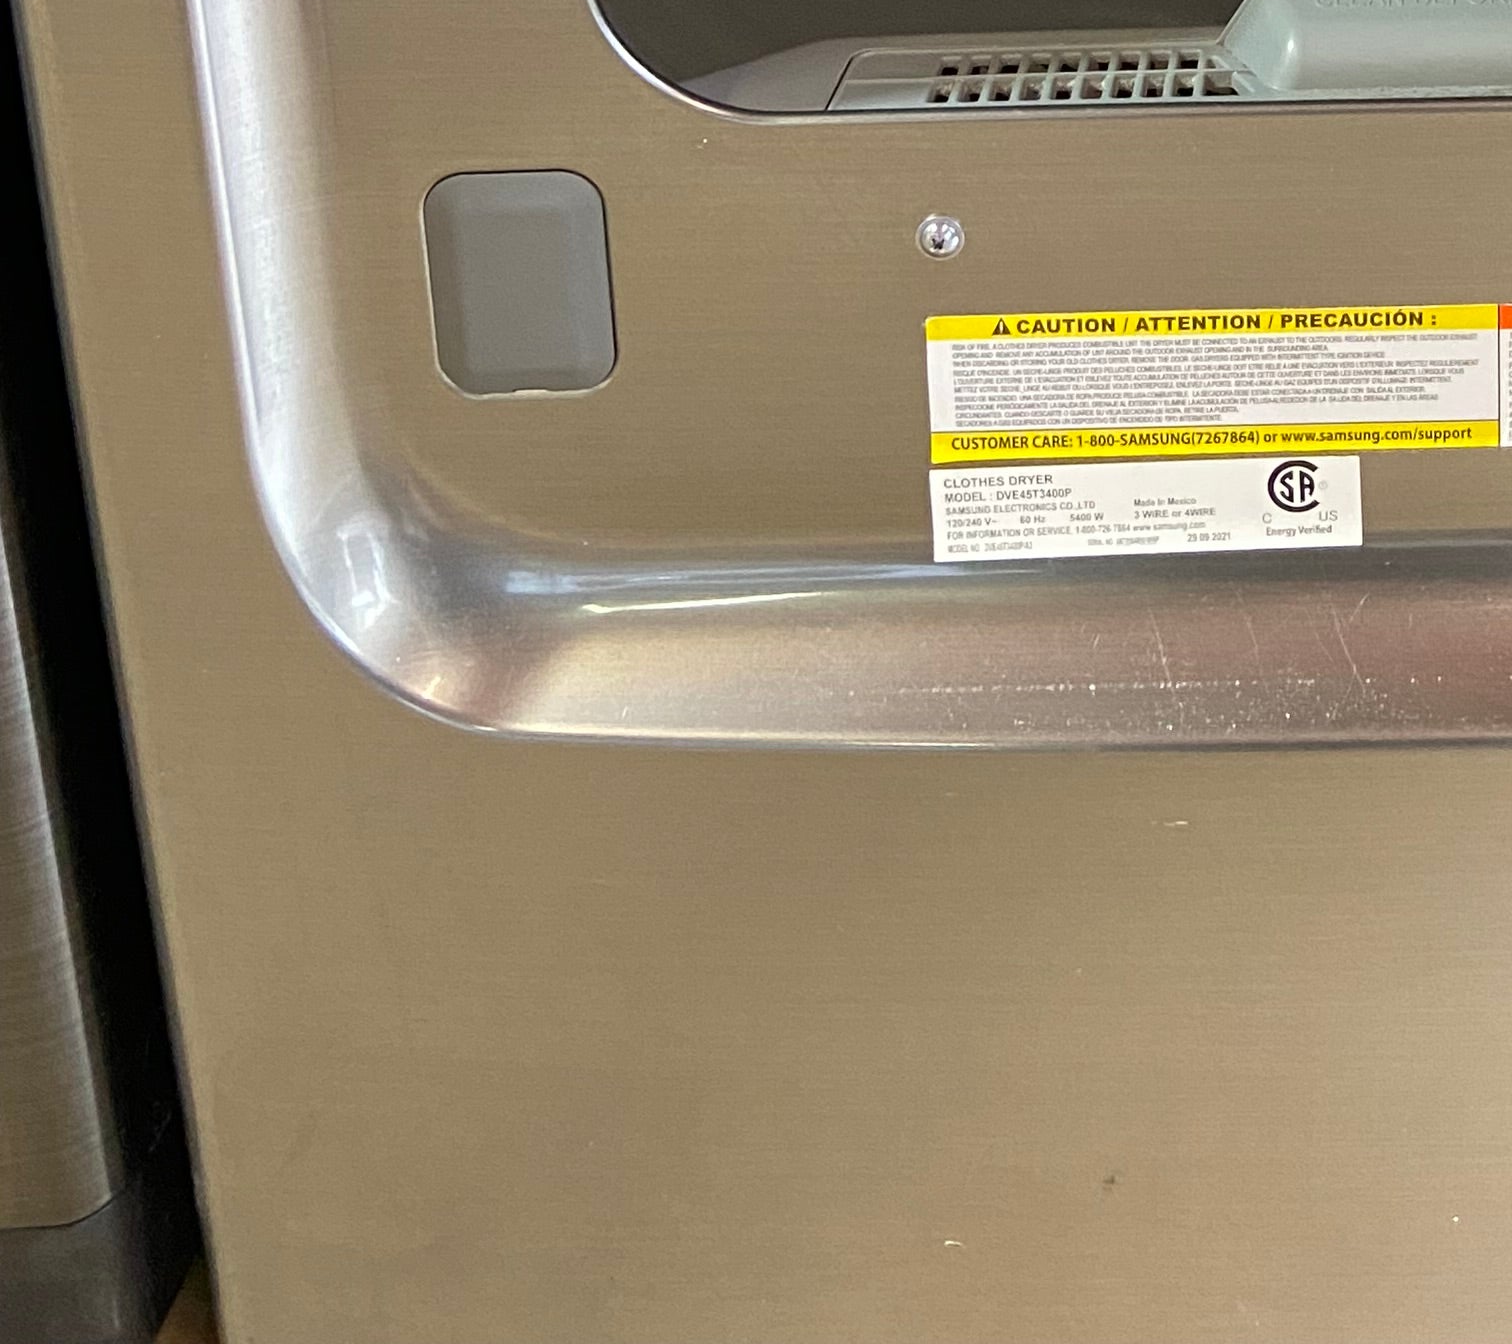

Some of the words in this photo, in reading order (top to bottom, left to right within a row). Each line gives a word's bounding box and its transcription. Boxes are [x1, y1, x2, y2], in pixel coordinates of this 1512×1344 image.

[1016, 318, 1115, 334] CAUTION
[1135, 315, 1261, 332] ATTENTION
[1280, 309, 1423, 329] PRECAUCIÓN
[951, 436, 1029, 450] CUSTOMER
[1032, 435, 1073, 449] CARE:
[1076, 430, 1260, 448] 1-800-SAMSUNG(7267864)
[1263, 433, 1278, 443] or
[1281, 427, 1472, 444] www.samsung.com/support
[943, 476, 1005, 489] CLOTHES
[1008, 474, 1053, 486] DRYER
[944, 492, 986, 503] MODEL
[996, 488, 1072, 501] DVE45T3400P
[1133, 498, 1155, 507] Made
[1167, 497, 1197, 505] Mexico
[945, 505, 991, 516] SAMSUNG
[993, 502, 1057, 514] ELECTRONICS
[1133, 510, 1140, 519] 3
[1142, 510, 1169, 518] WIRE
[1184, 508, 1216, 517] 4WIRE
[1318, 510, 1338, 522] US
[946, 518, 982, 528] 120/240
[1019, 516, 1031, 524] 60
[1033, 515, 1046, 523] Hz
[1070, 513, 1092, 522] 5400
[1094, 512, 1105, 521] W
[946, 531, 964, 540] FOR
[966, 529, 1021, 539] INFORMATION
[1022, 528, 1035, 537] OR
[1266, 526, 1297, 537] Energy
[1297, 524, 1333, 535] Verified
